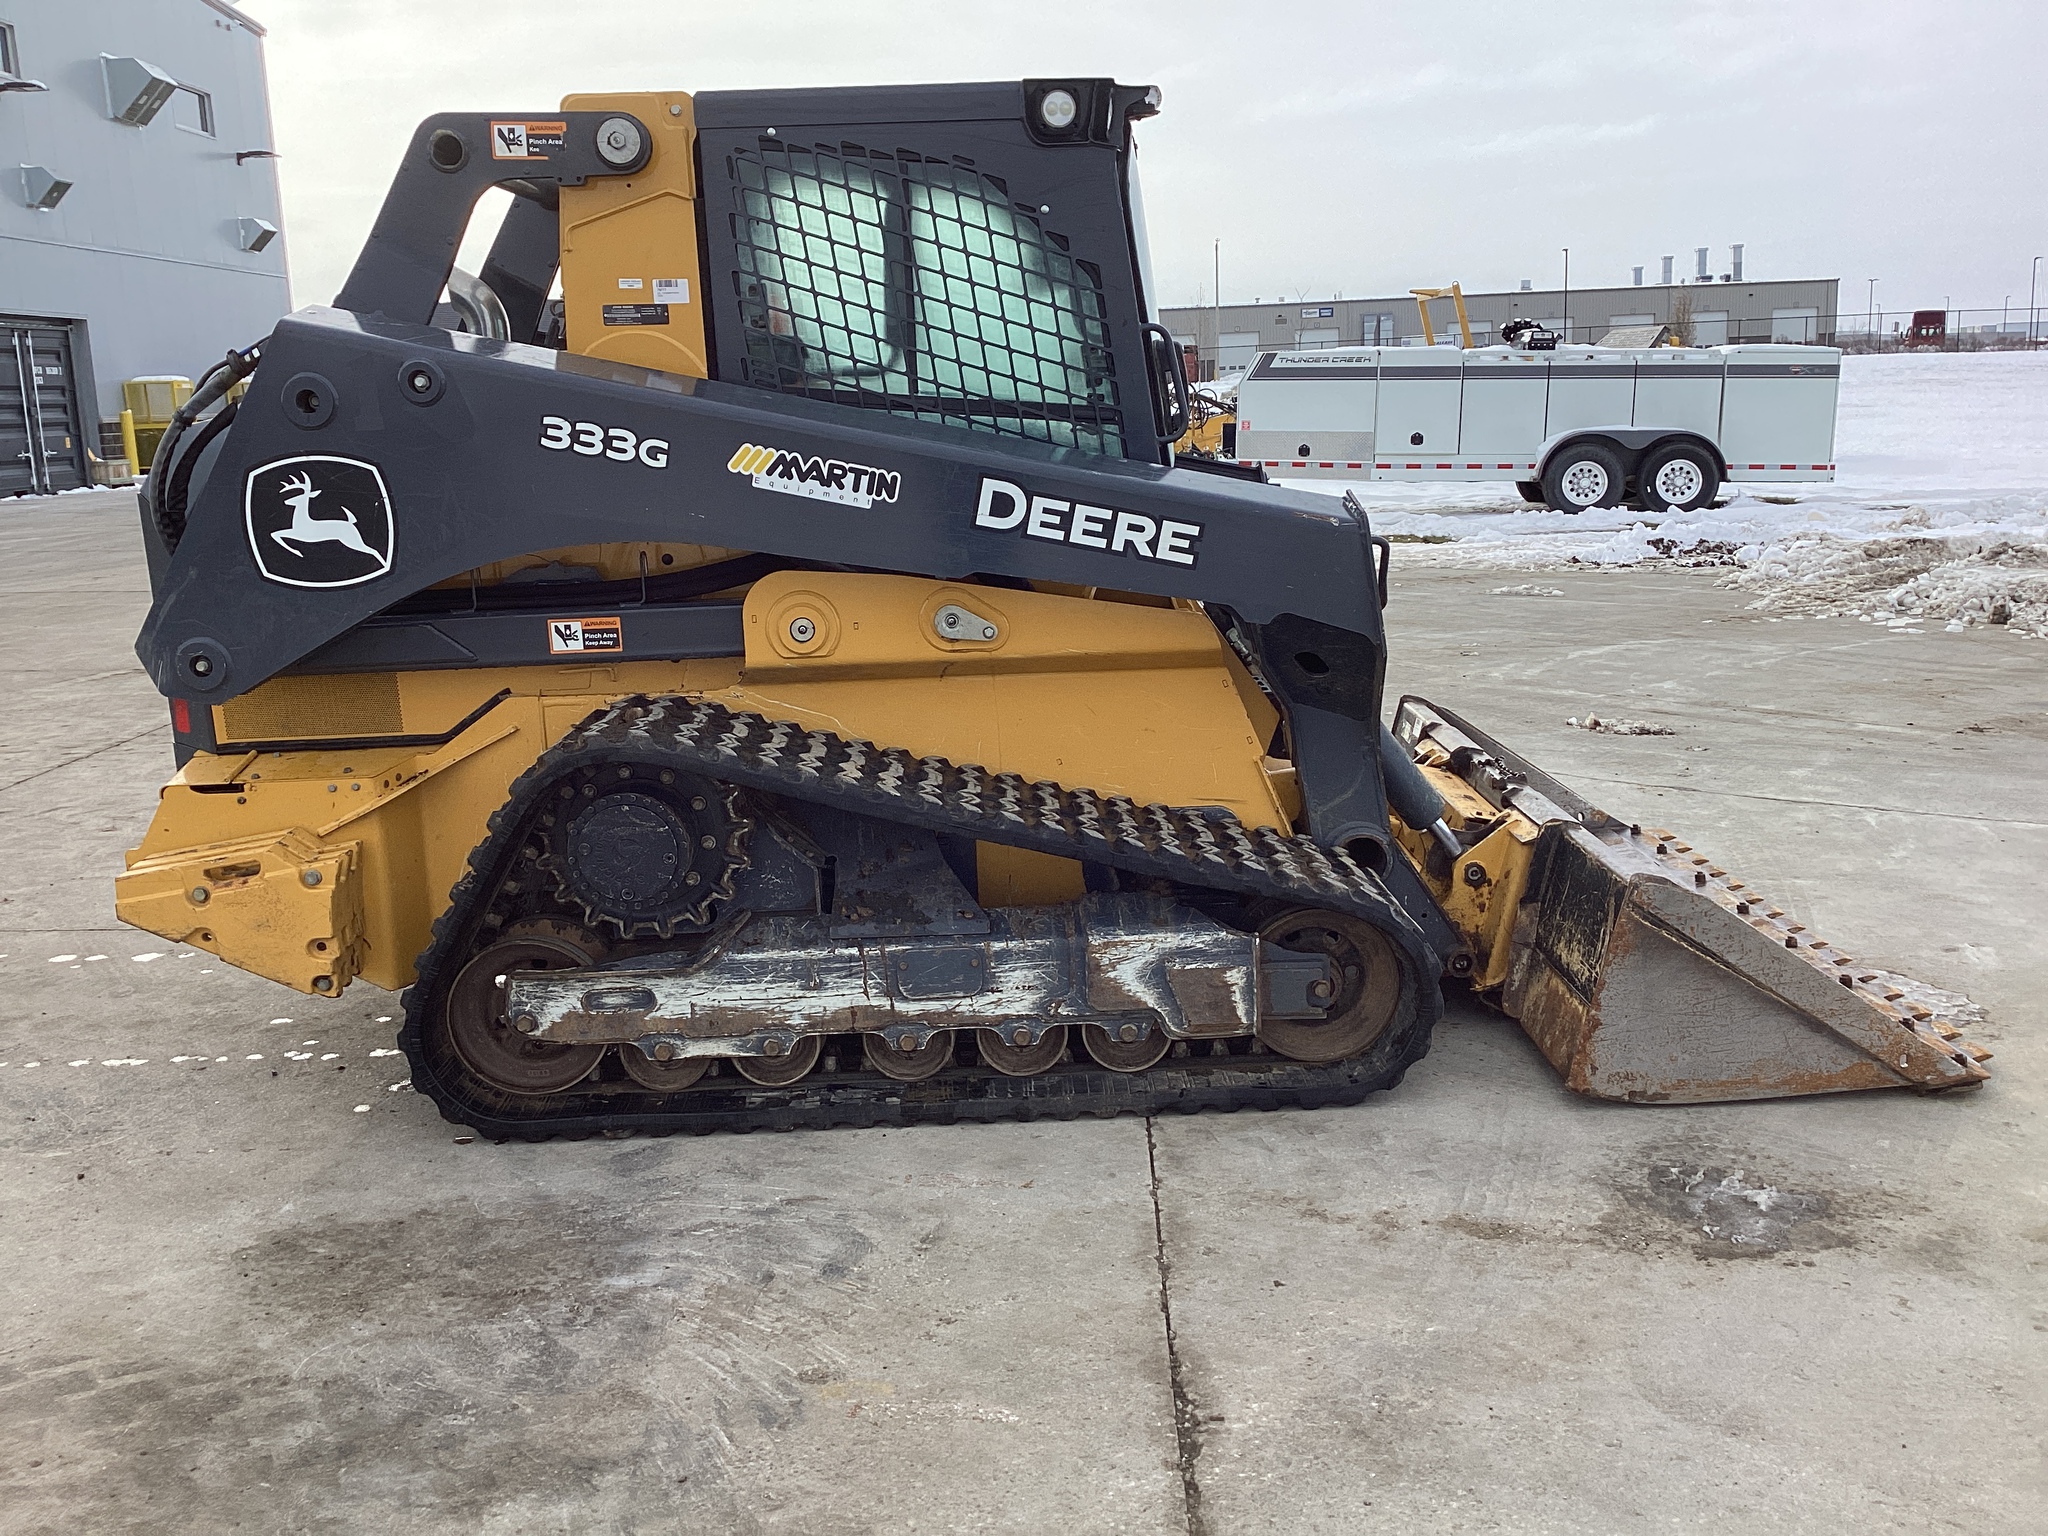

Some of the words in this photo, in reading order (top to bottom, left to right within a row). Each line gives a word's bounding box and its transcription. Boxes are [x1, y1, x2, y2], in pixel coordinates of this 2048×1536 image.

[540, 416, 669, 468] 333G
[754, 477, 871, 505] Equipment
[765, 453, 898, 500] MARTIN
[975, 477, 1200, 565] DEERE
